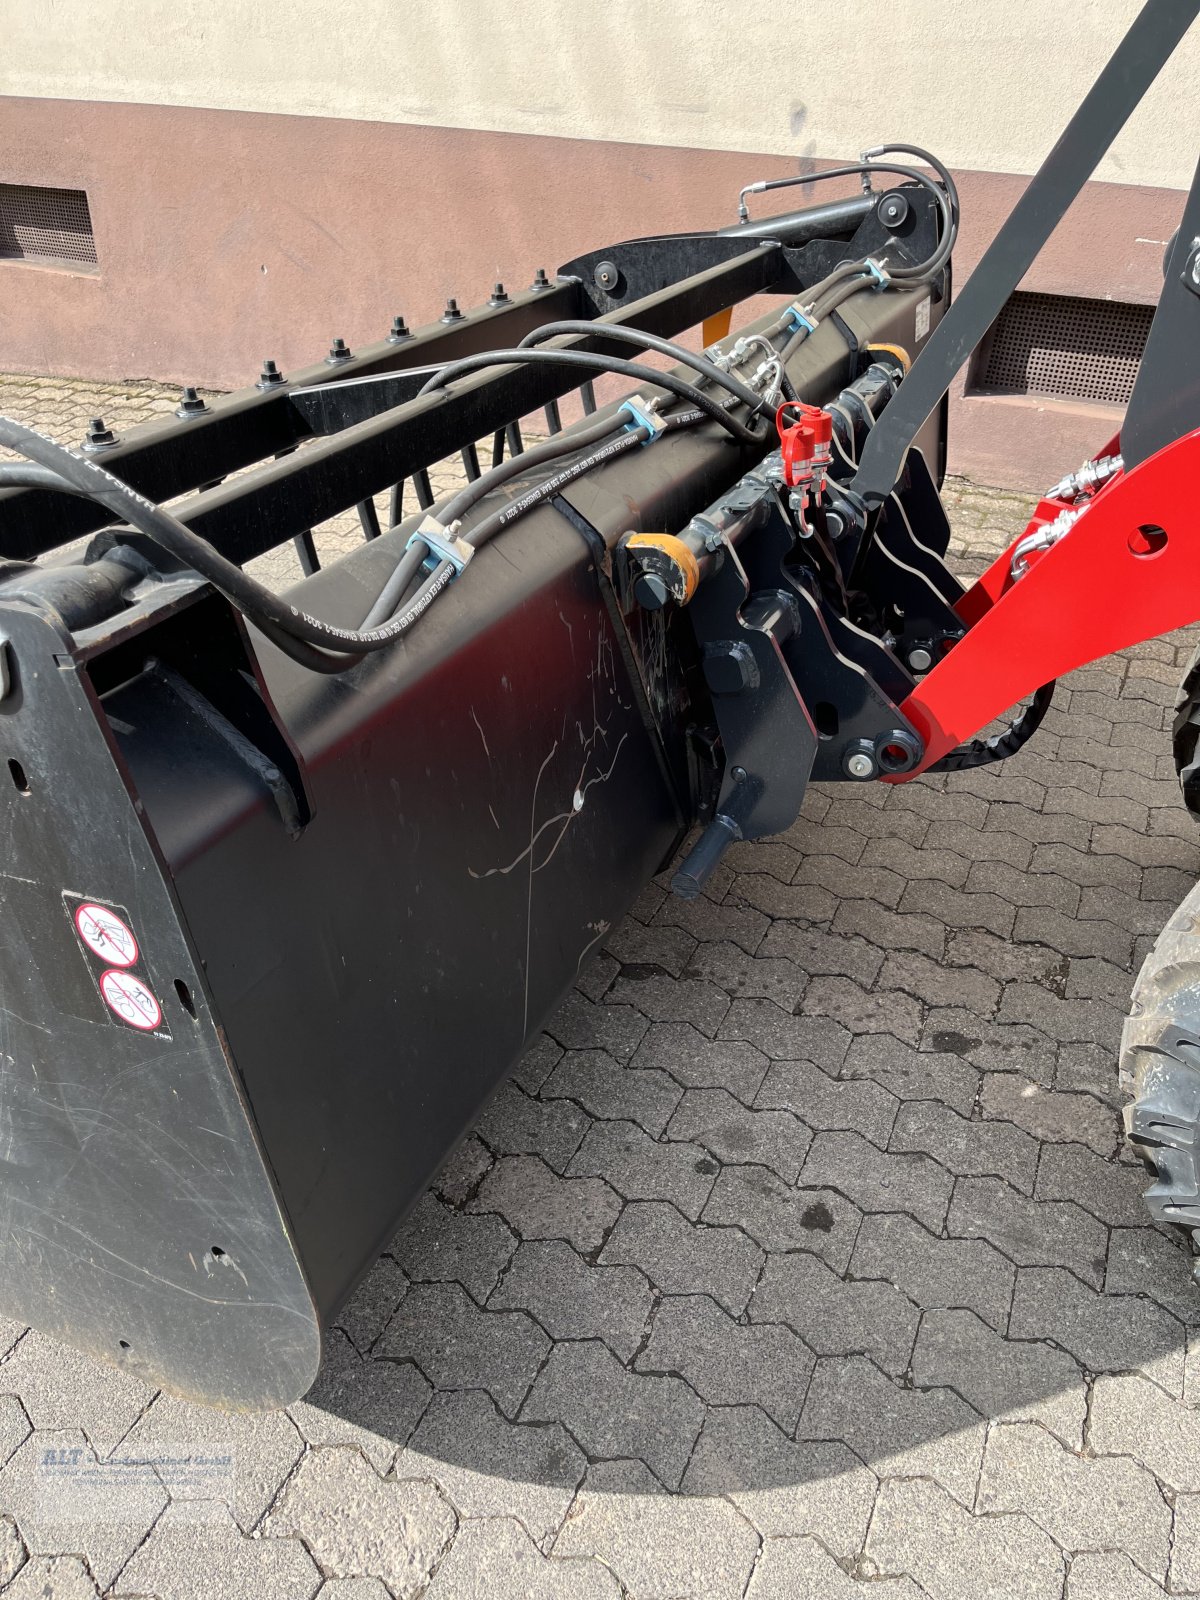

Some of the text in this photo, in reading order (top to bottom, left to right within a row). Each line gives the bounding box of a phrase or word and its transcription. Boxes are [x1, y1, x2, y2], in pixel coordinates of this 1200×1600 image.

[61, 446, 156, 512] HANSA-FLEX
[430, 563, 454, 597] HANSA-FLEX
[302, 612, 322, 629] 3Q21
